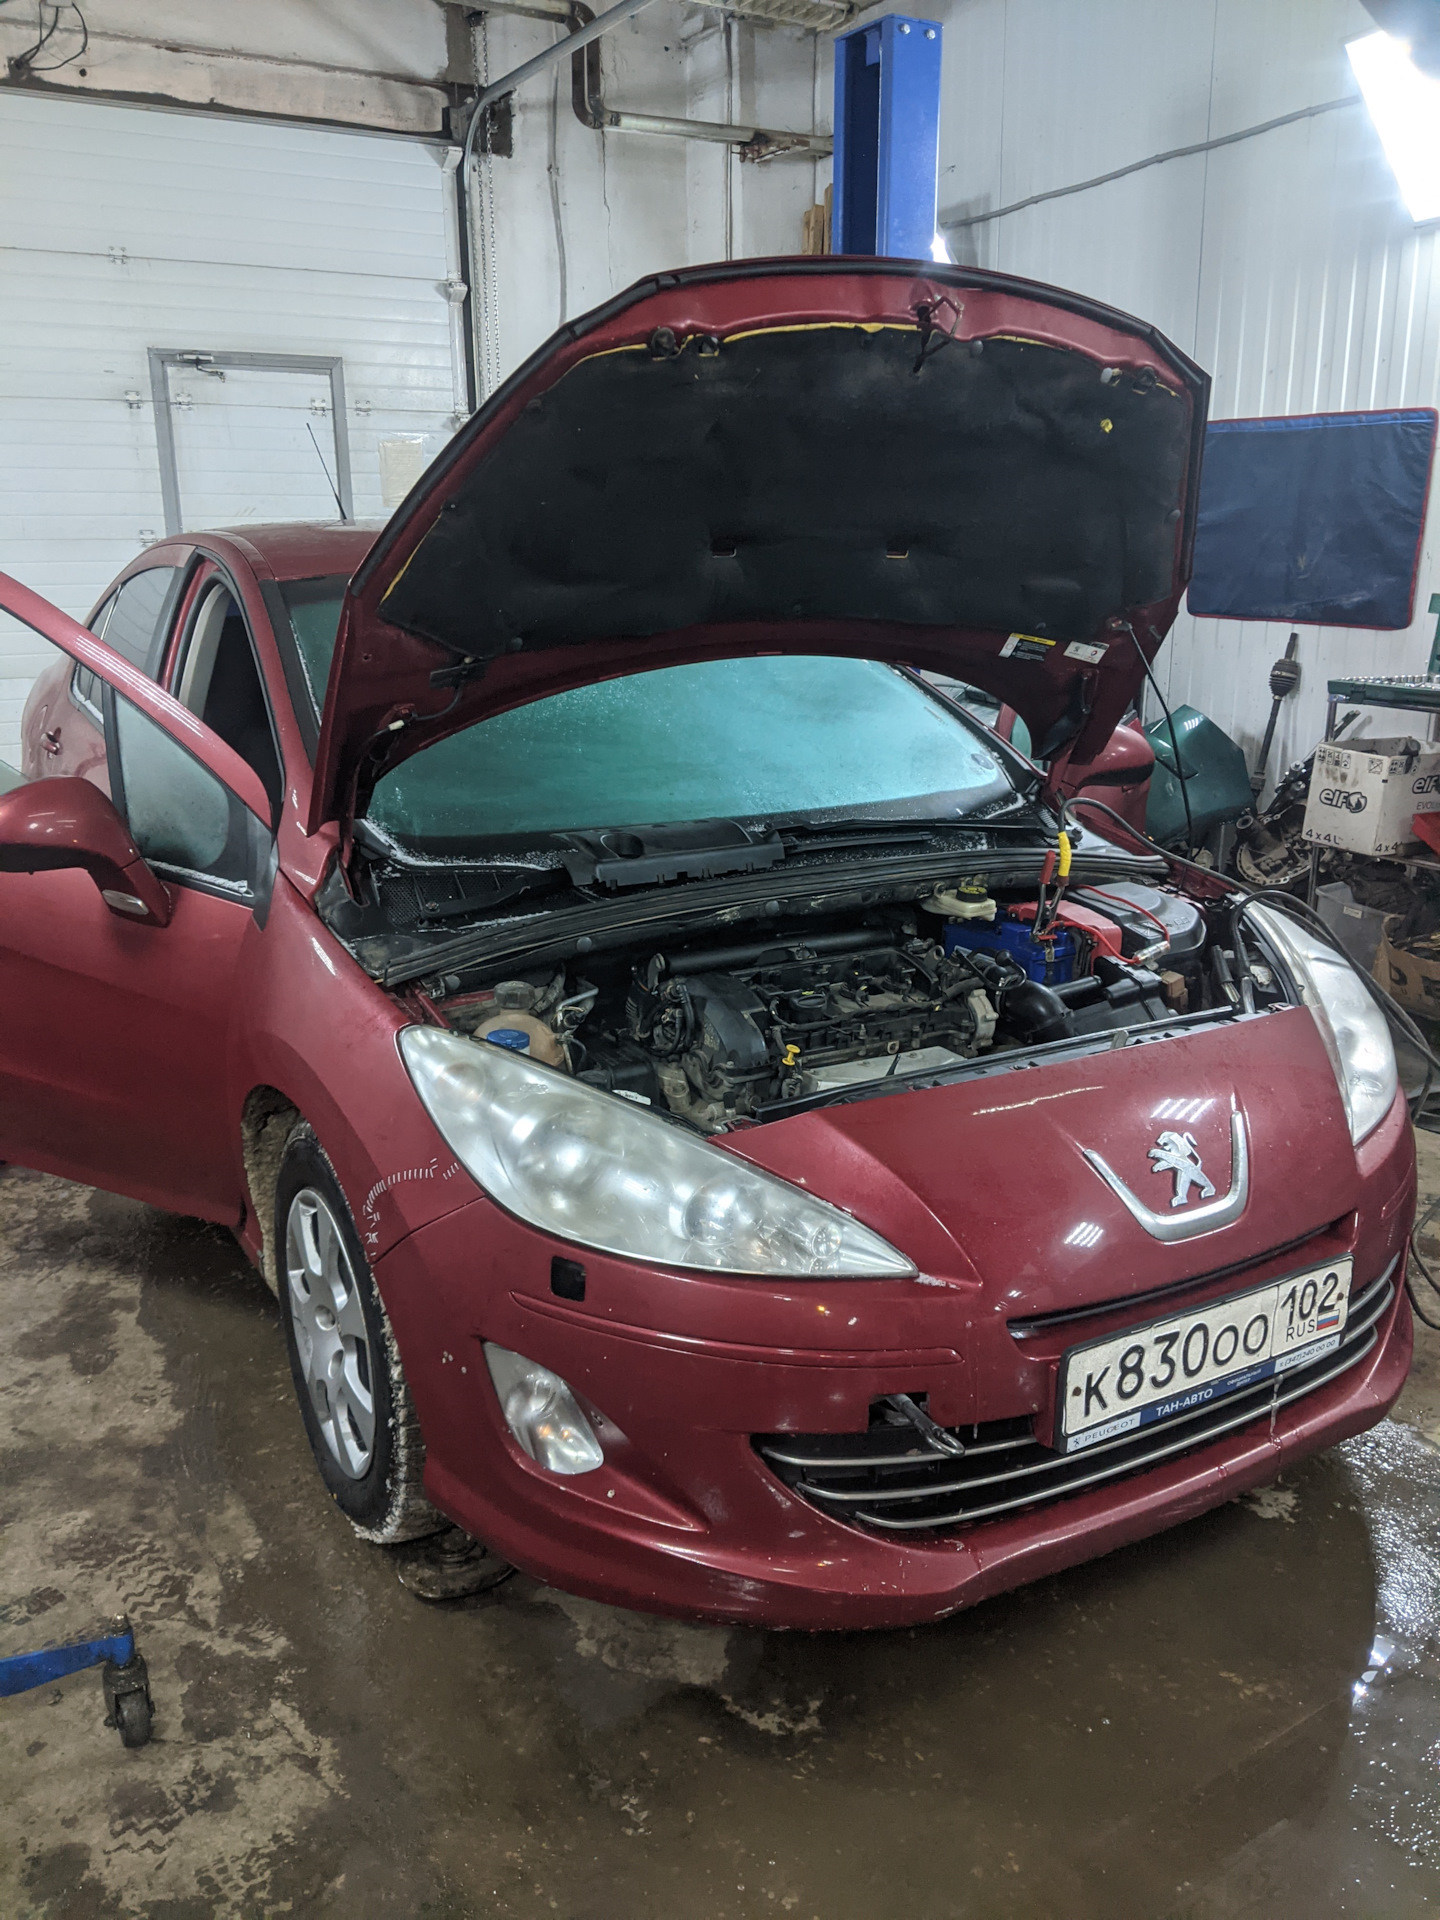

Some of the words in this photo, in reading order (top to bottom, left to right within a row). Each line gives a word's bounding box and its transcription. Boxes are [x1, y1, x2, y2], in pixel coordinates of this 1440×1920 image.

[1319, 788, 1349, 809] elf
[1281, 1272, 1339, 1327] 102
[1286, 1319, 1316, 1342] RUS
[1084, 1418, 1135, 1442] PEUGEOT
